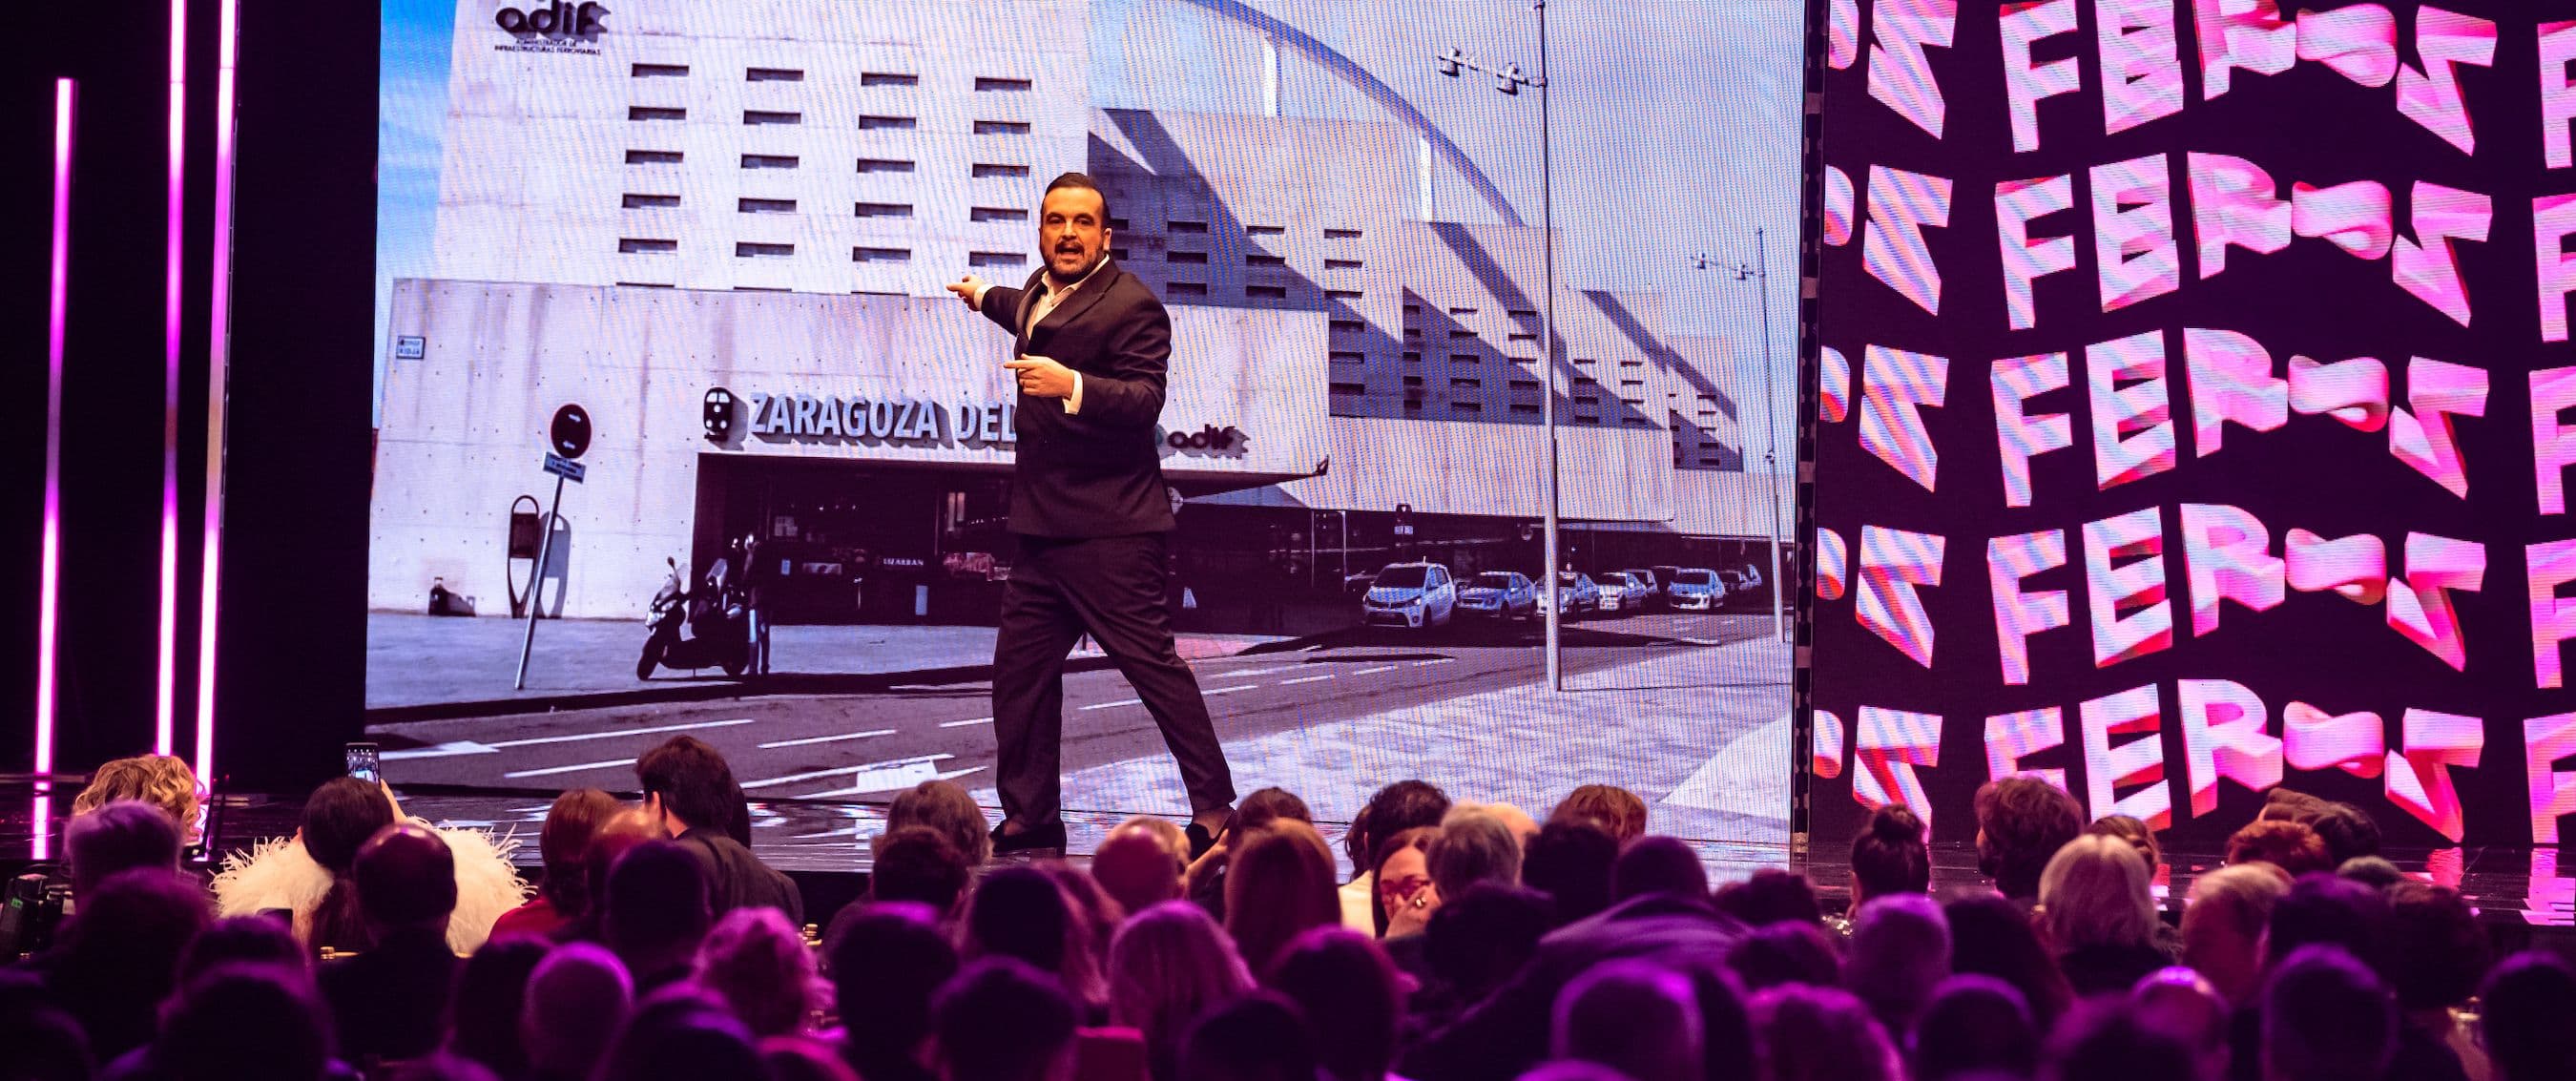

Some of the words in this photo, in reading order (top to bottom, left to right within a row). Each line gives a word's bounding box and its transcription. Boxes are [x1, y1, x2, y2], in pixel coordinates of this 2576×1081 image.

[495, 0, 603, 36] adif
[749, 391, 939, 439] ZARAGOZA
[1167, 424, 1242, 450] adif
